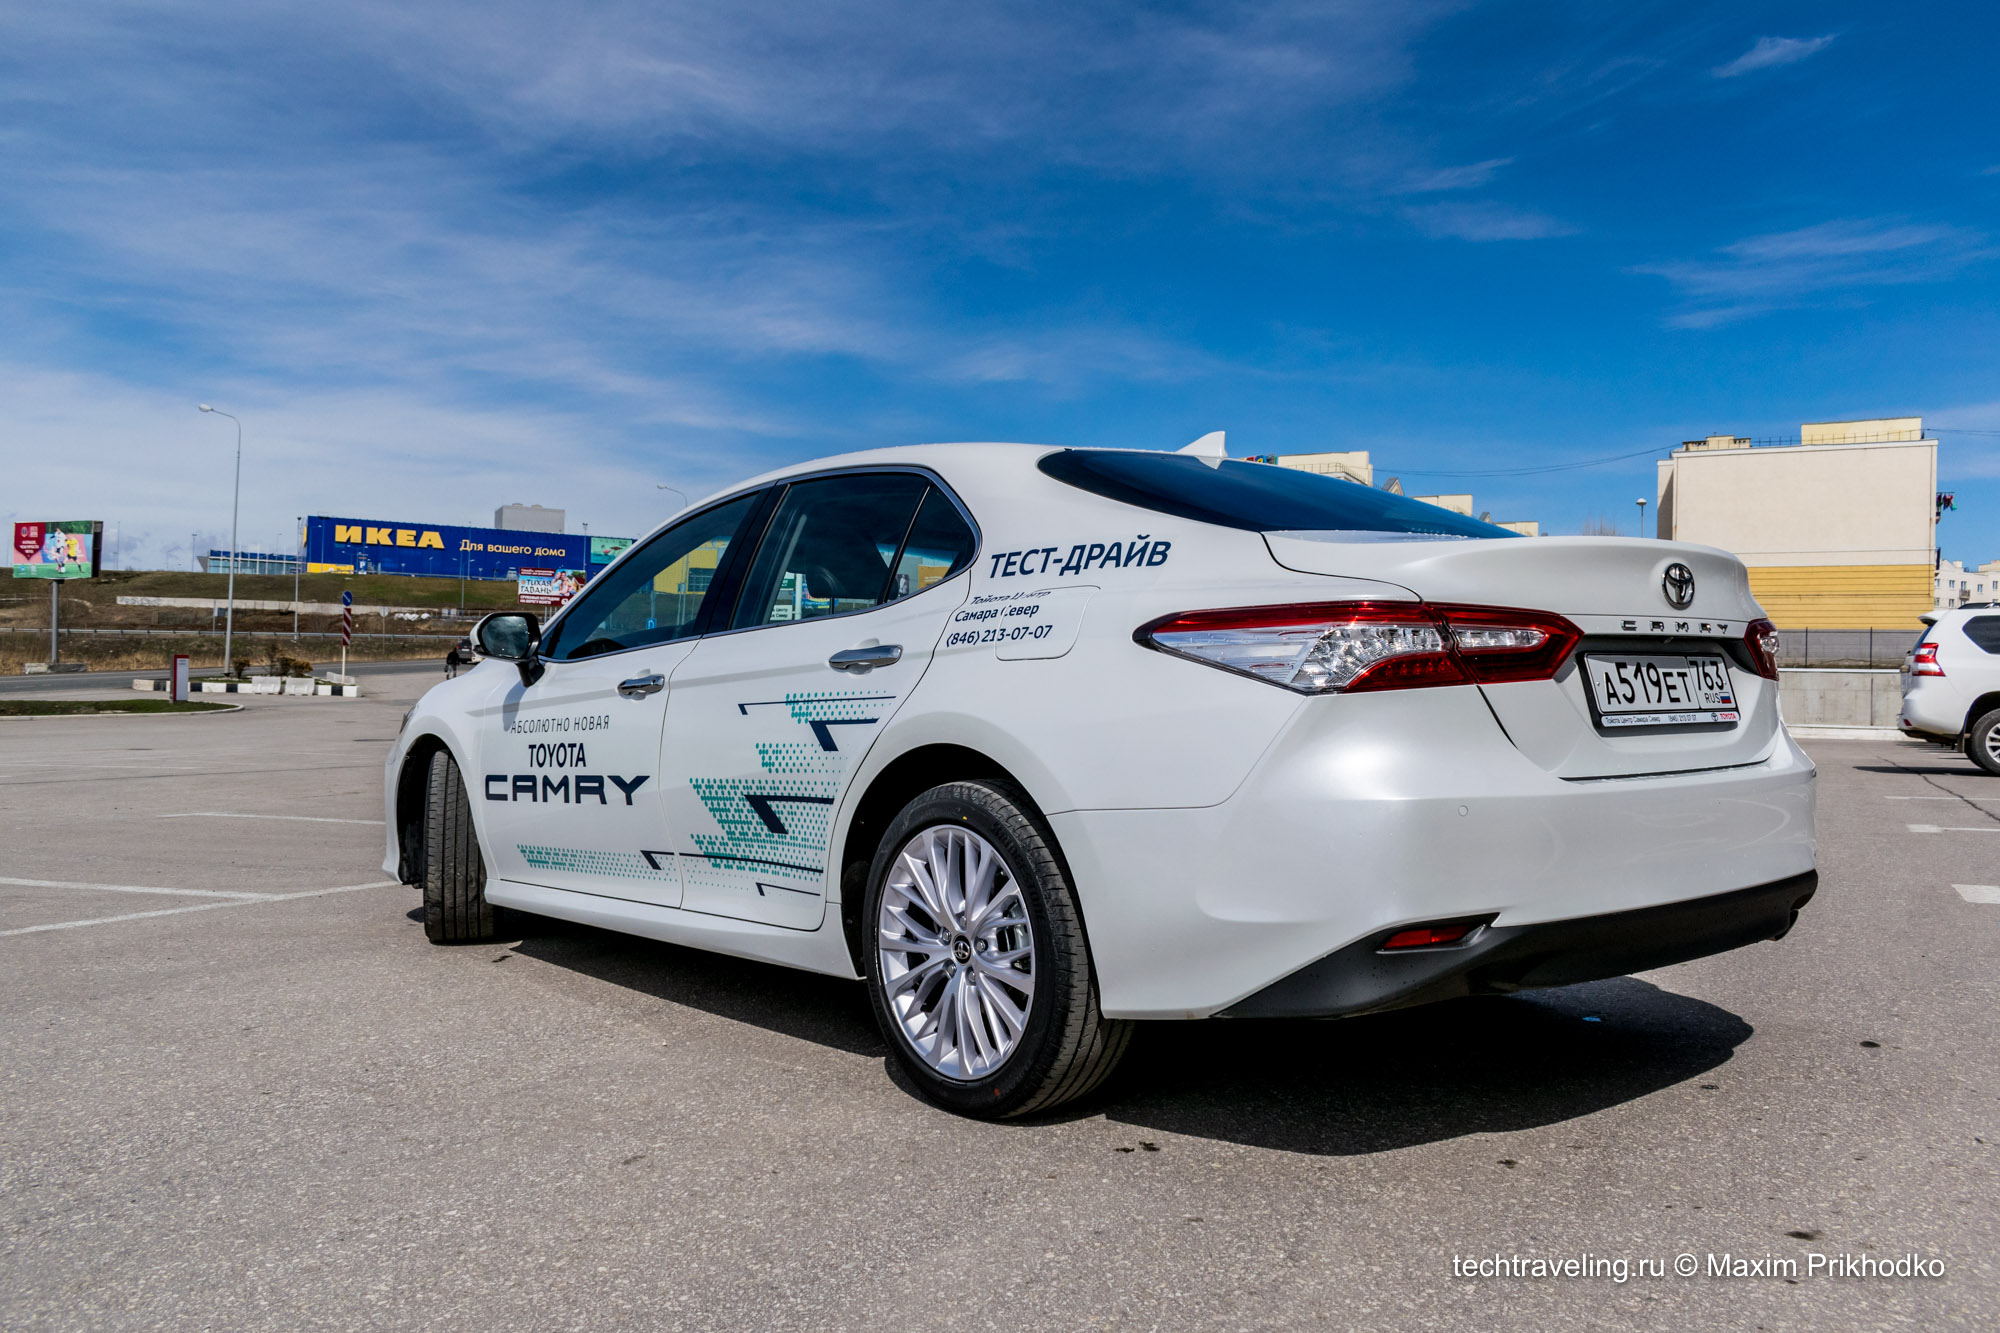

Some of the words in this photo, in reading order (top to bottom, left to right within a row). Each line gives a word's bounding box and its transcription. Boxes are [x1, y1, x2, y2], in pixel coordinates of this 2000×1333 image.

[335, 525, 445, 549] ИКЕА
[459, 539, 484, 552] Для
[487, 543, 532, 555] вашего
[534, 546, 566, 557] дома
[989, 534, 1172, 579] ТЕСТ-ДРАЙВ
[520, 585, 552, 595] ГАВАНЬ
[1010, 591, 1051, 601] Цнтр
[954, 608, 999, 622] Самара
[1000, 604, 1040, 618] Север
[946, 630, 980, 648] (846)
[981, 624, 1053, 643] 213-07-07
[1621, 620, 1728, 634] CAMRY
[1688, 660, 1725, 691] 763
[1704, 692, 1721, 704] RUS
[510, 717, 570, 734] АБСОЛЮТНО
[573, 715, 610, 732] НОВАЯ
[528, 742, 587, 768] TOYOTA
[485, 774, 650, 806] CAMRY
